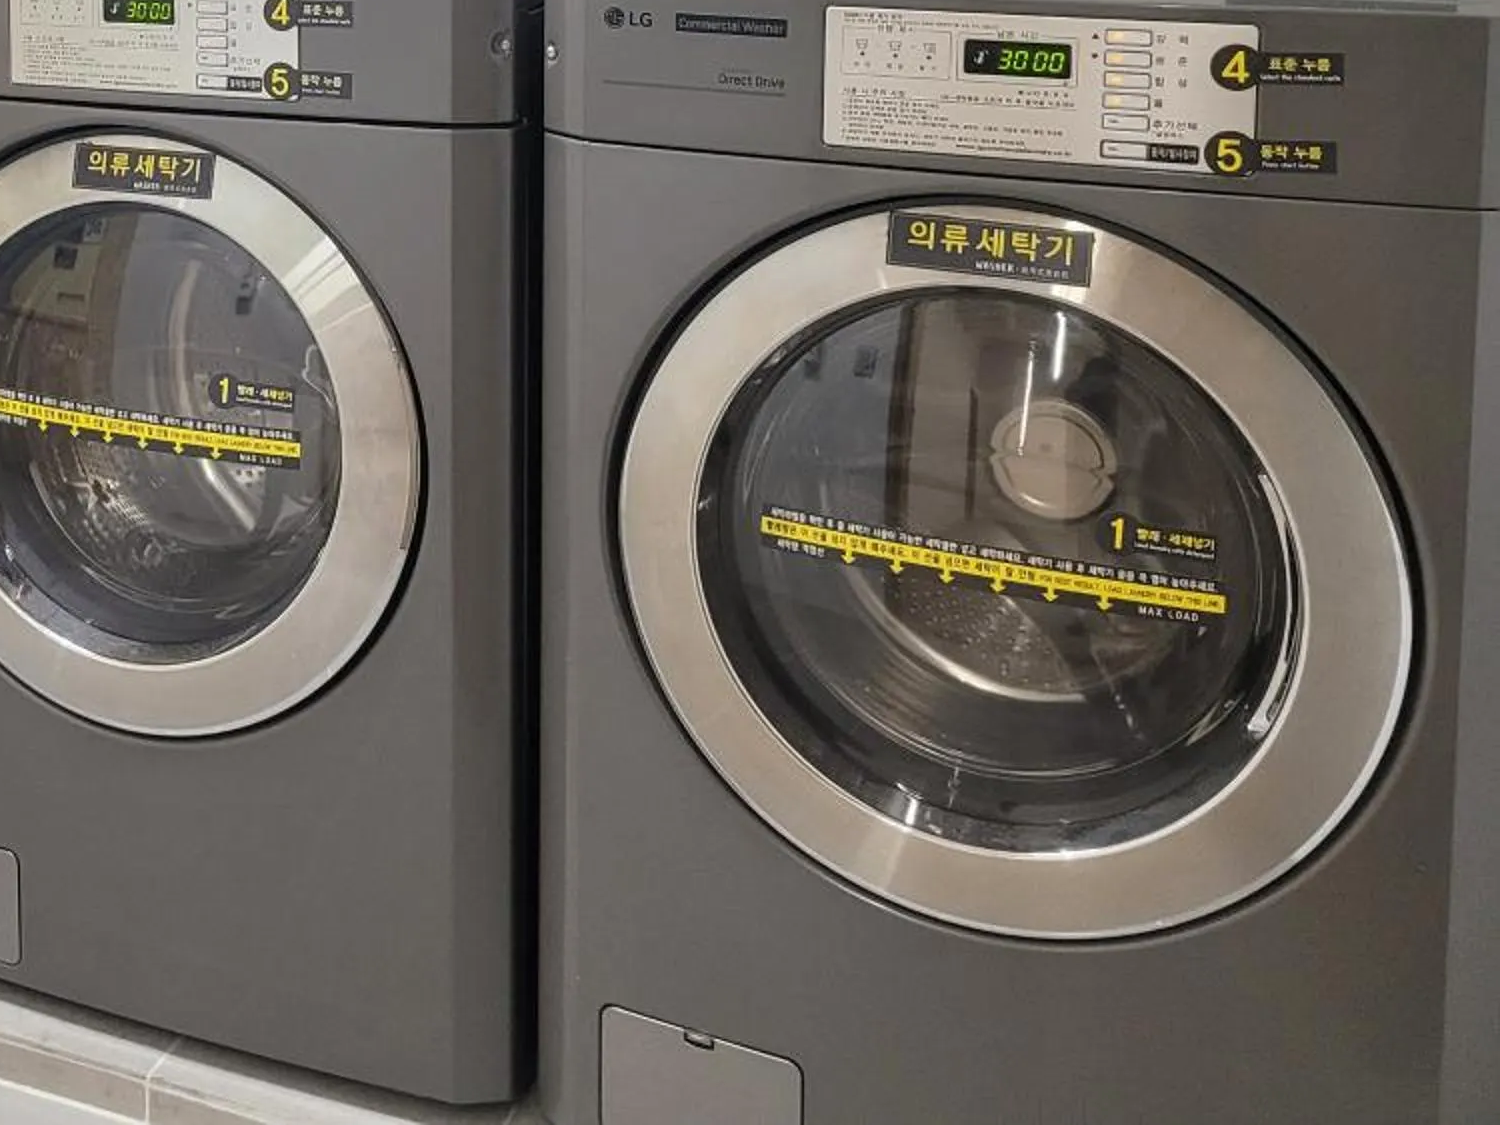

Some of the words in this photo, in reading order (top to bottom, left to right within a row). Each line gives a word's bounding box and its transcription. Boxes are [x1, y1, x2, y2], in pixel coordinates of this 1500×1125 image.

[629, 11, 653, 27] LG
[1221, 50, 1249, 84] 4
[1300, 58, 1331, 72] 누름
[271, 68, 289, 96] 5
[718, 73, 752, 87] Direct
[756, 75, 786, 90] Drive
[88, 150, 201, 183] 의류세탁기
[1216, 138, 1241, 171] 5
[1293, 146, 1322, 161] 누름
[908, 221, 1073, 265] 의류세탁기
[219, 377, 229, 404] 1
[1110, 517, 1125, 549] 1
[1138, 606, 1163, 618] MAX
[1167, 610, 1199, 622] LOAD
